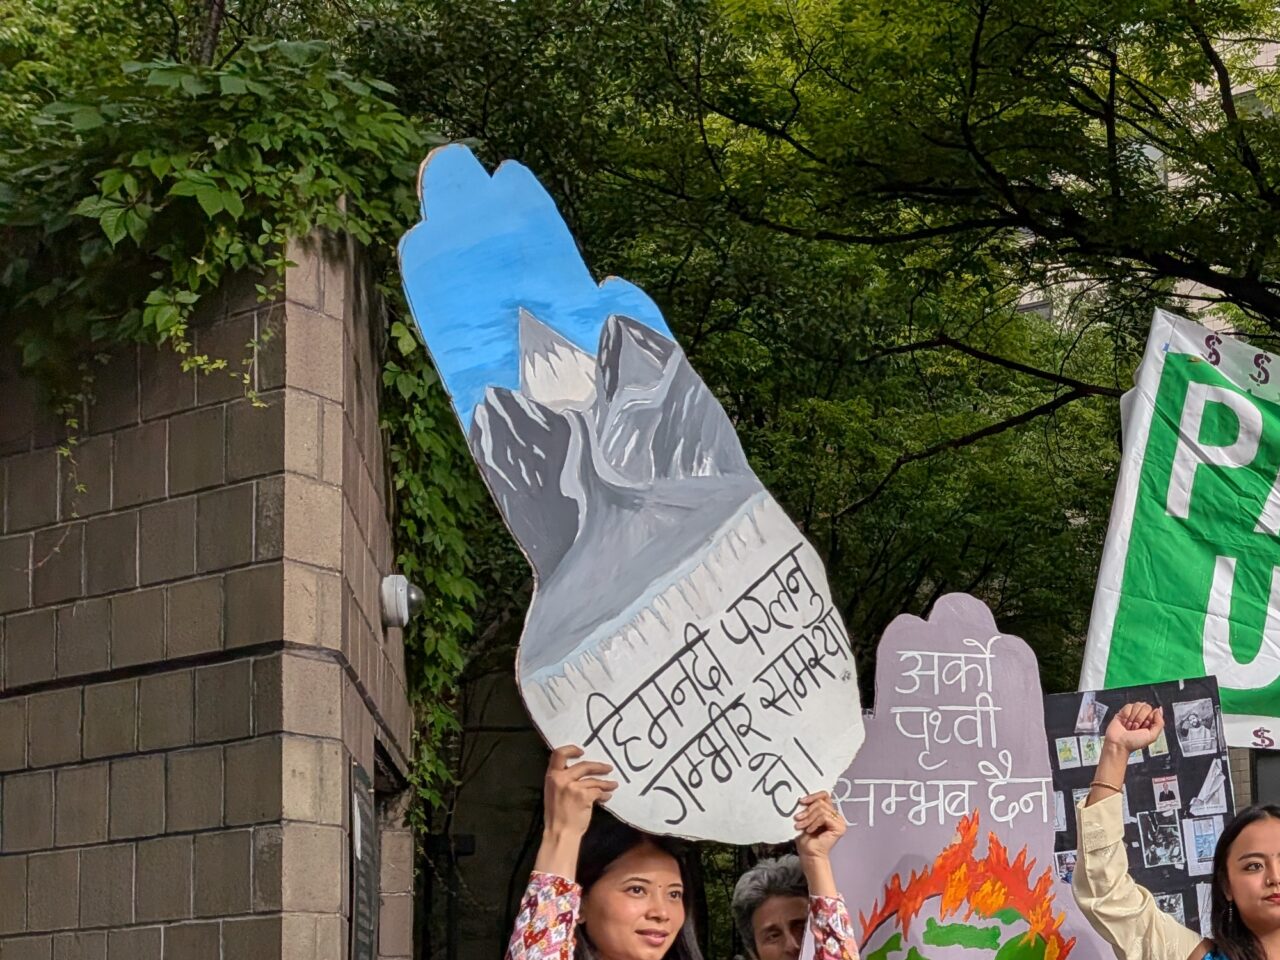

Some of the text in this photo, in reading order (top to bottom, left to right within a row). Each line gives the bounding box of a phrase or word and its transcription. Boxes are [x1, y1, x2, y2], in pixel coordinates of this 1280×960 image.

[583, 622, 733, 784] हिमनदी
[639, 692, 771, 825] गम्भीर
[978, 750, 1053, 828] छैन
